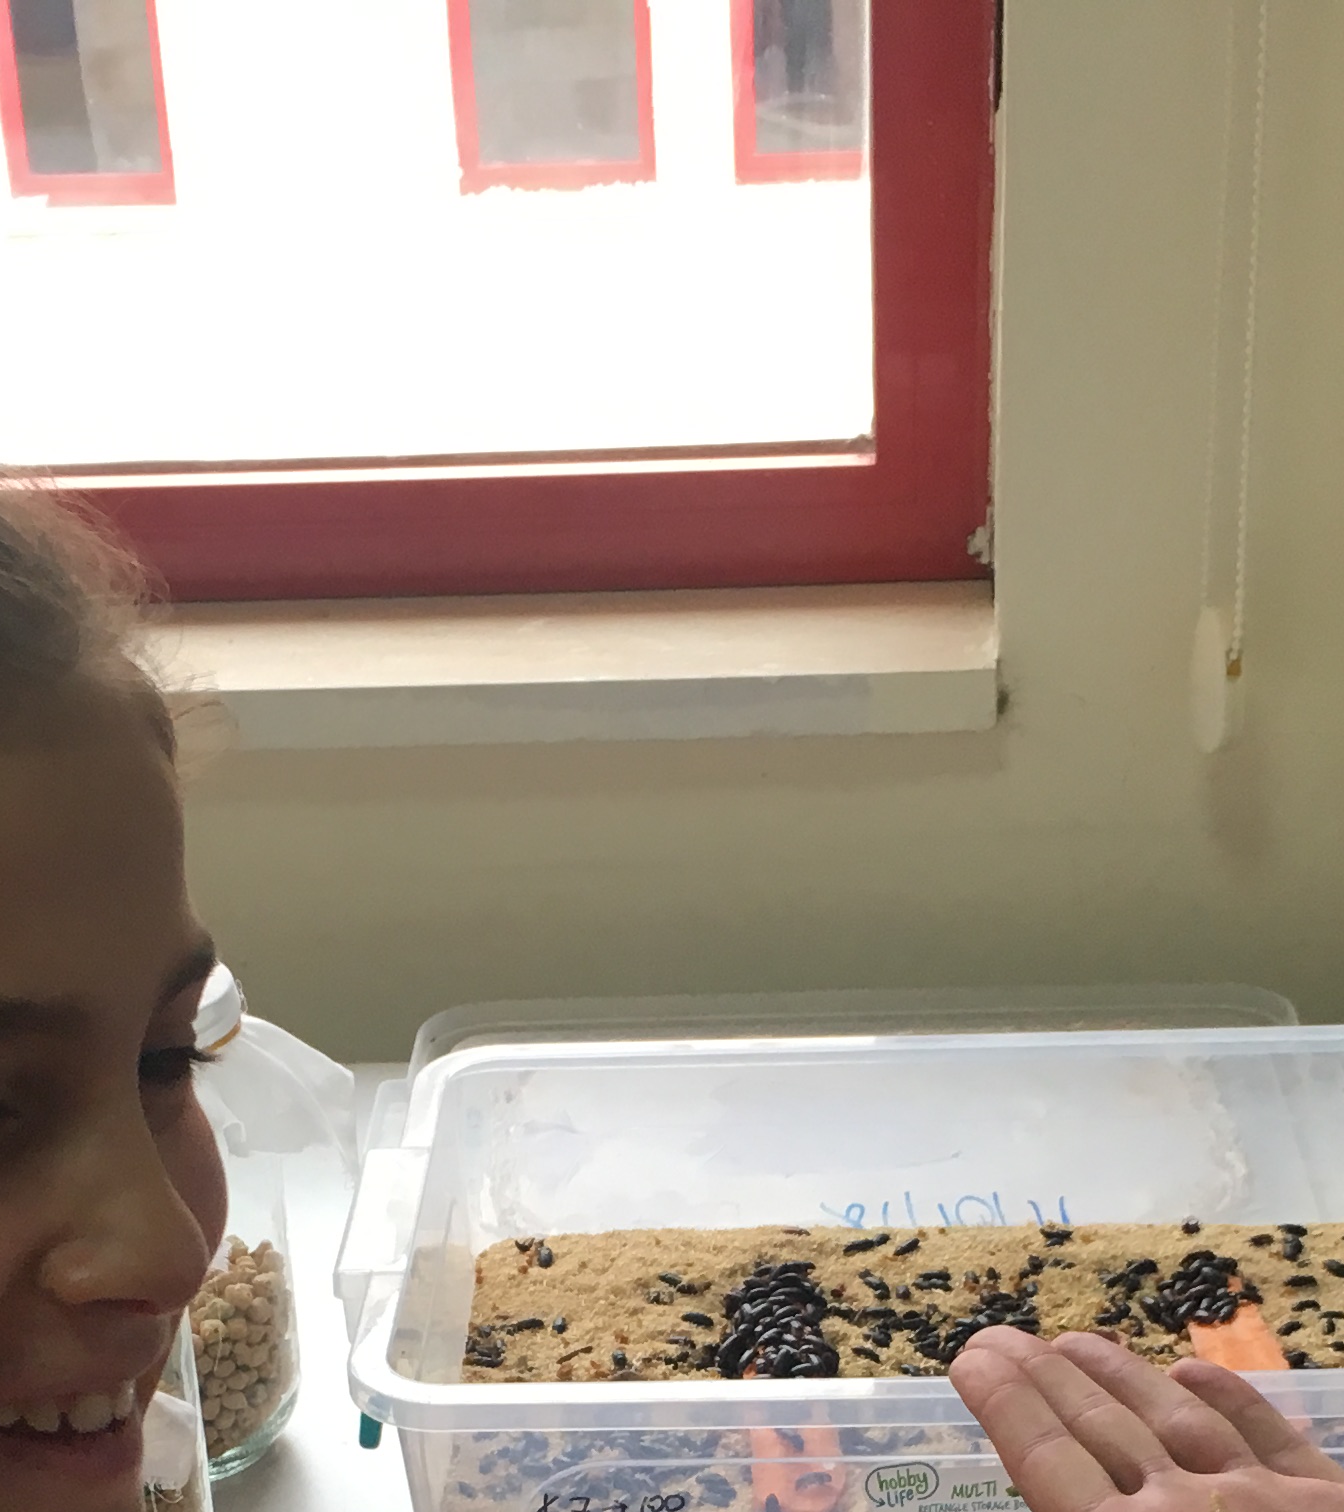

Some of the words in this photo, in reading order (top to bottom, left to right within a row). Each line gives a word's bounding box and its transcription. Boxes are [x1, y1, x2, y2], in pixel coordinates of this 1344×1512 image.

[876, 1467, 929, 1495] hobby
[950, 1480, 997, 1500] MULTI
[971, 1499, 1011, 1512] STORAGE
